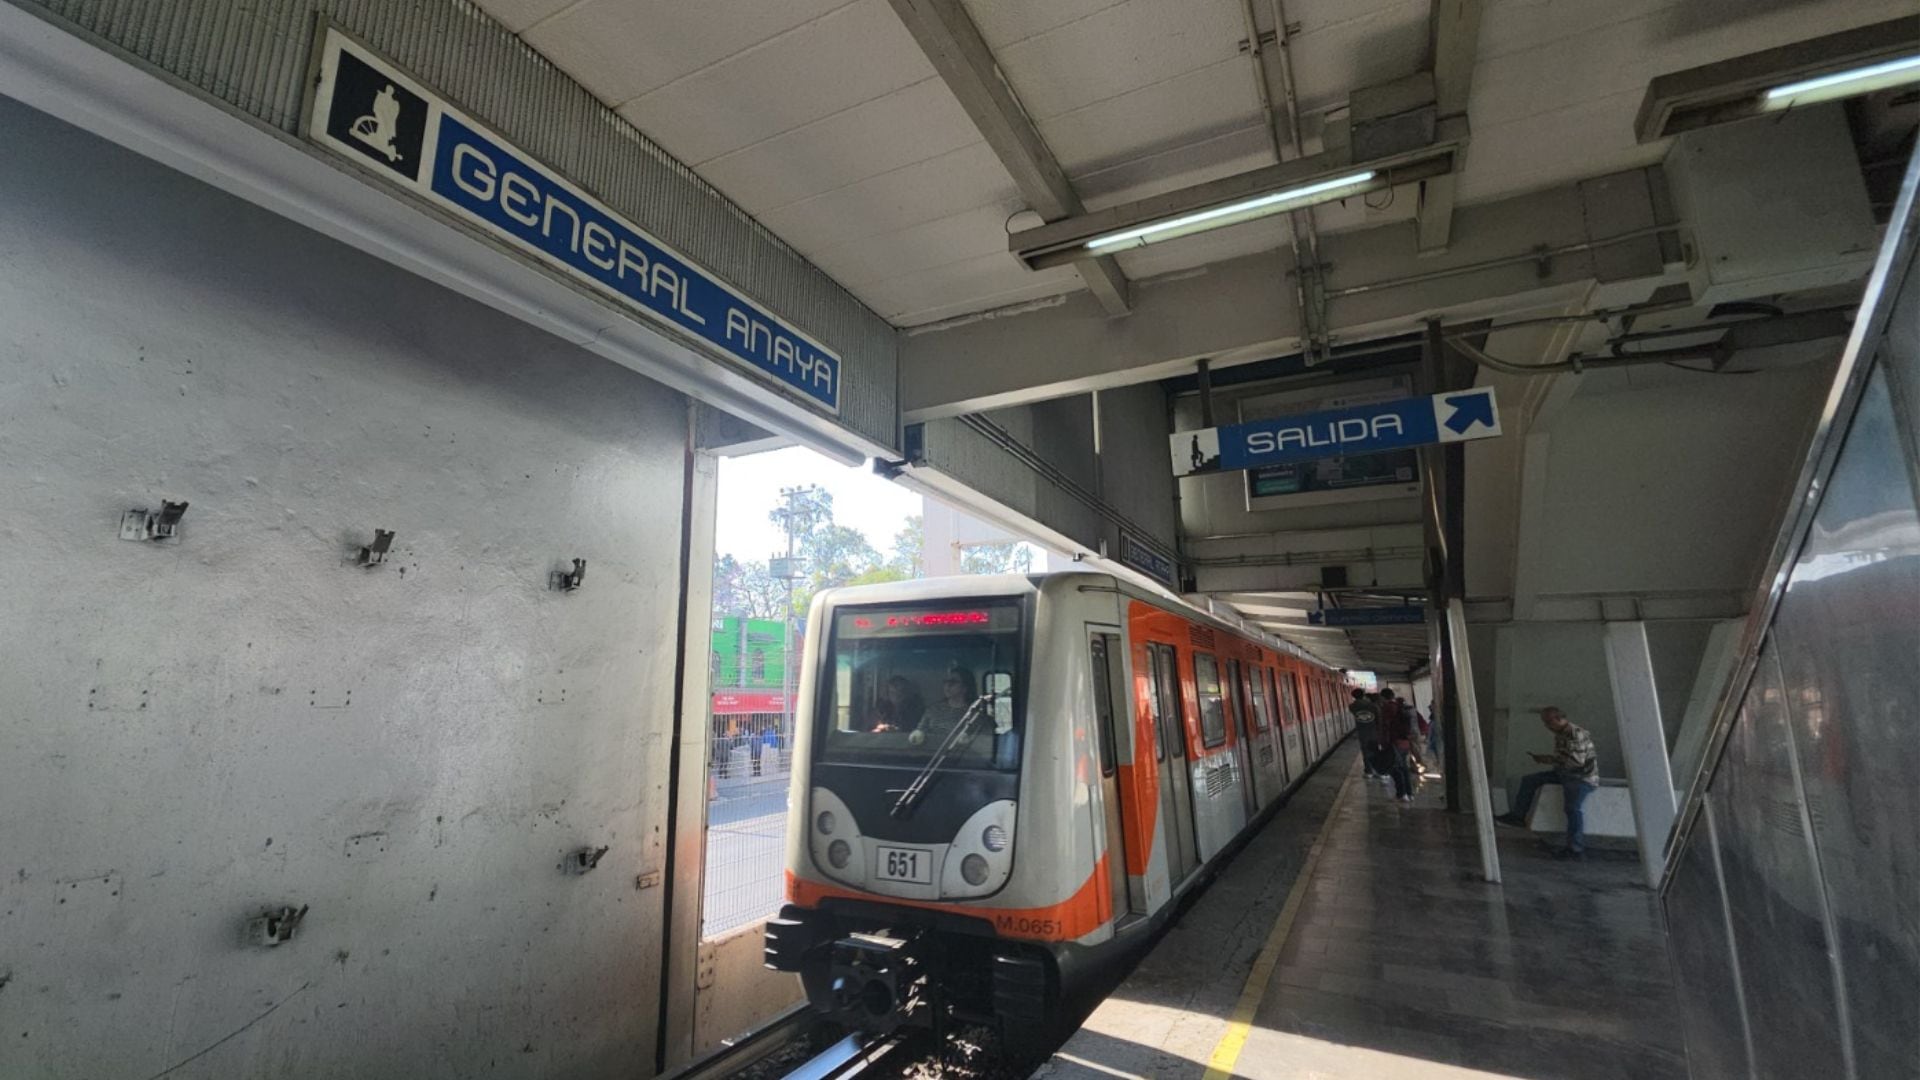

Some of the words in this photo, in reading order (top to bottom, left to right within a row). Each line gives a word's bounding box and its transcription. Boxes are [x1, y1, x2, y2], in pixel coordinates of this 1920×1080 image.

[452, 142, 705, 326] GENERAL
[726, 307, 831, 395] ANAYA
[1247, 413, 1403, 454] SALIDA
[887, 851, 918, 878] 651
[996, 914, 1062, 935] M.0651
